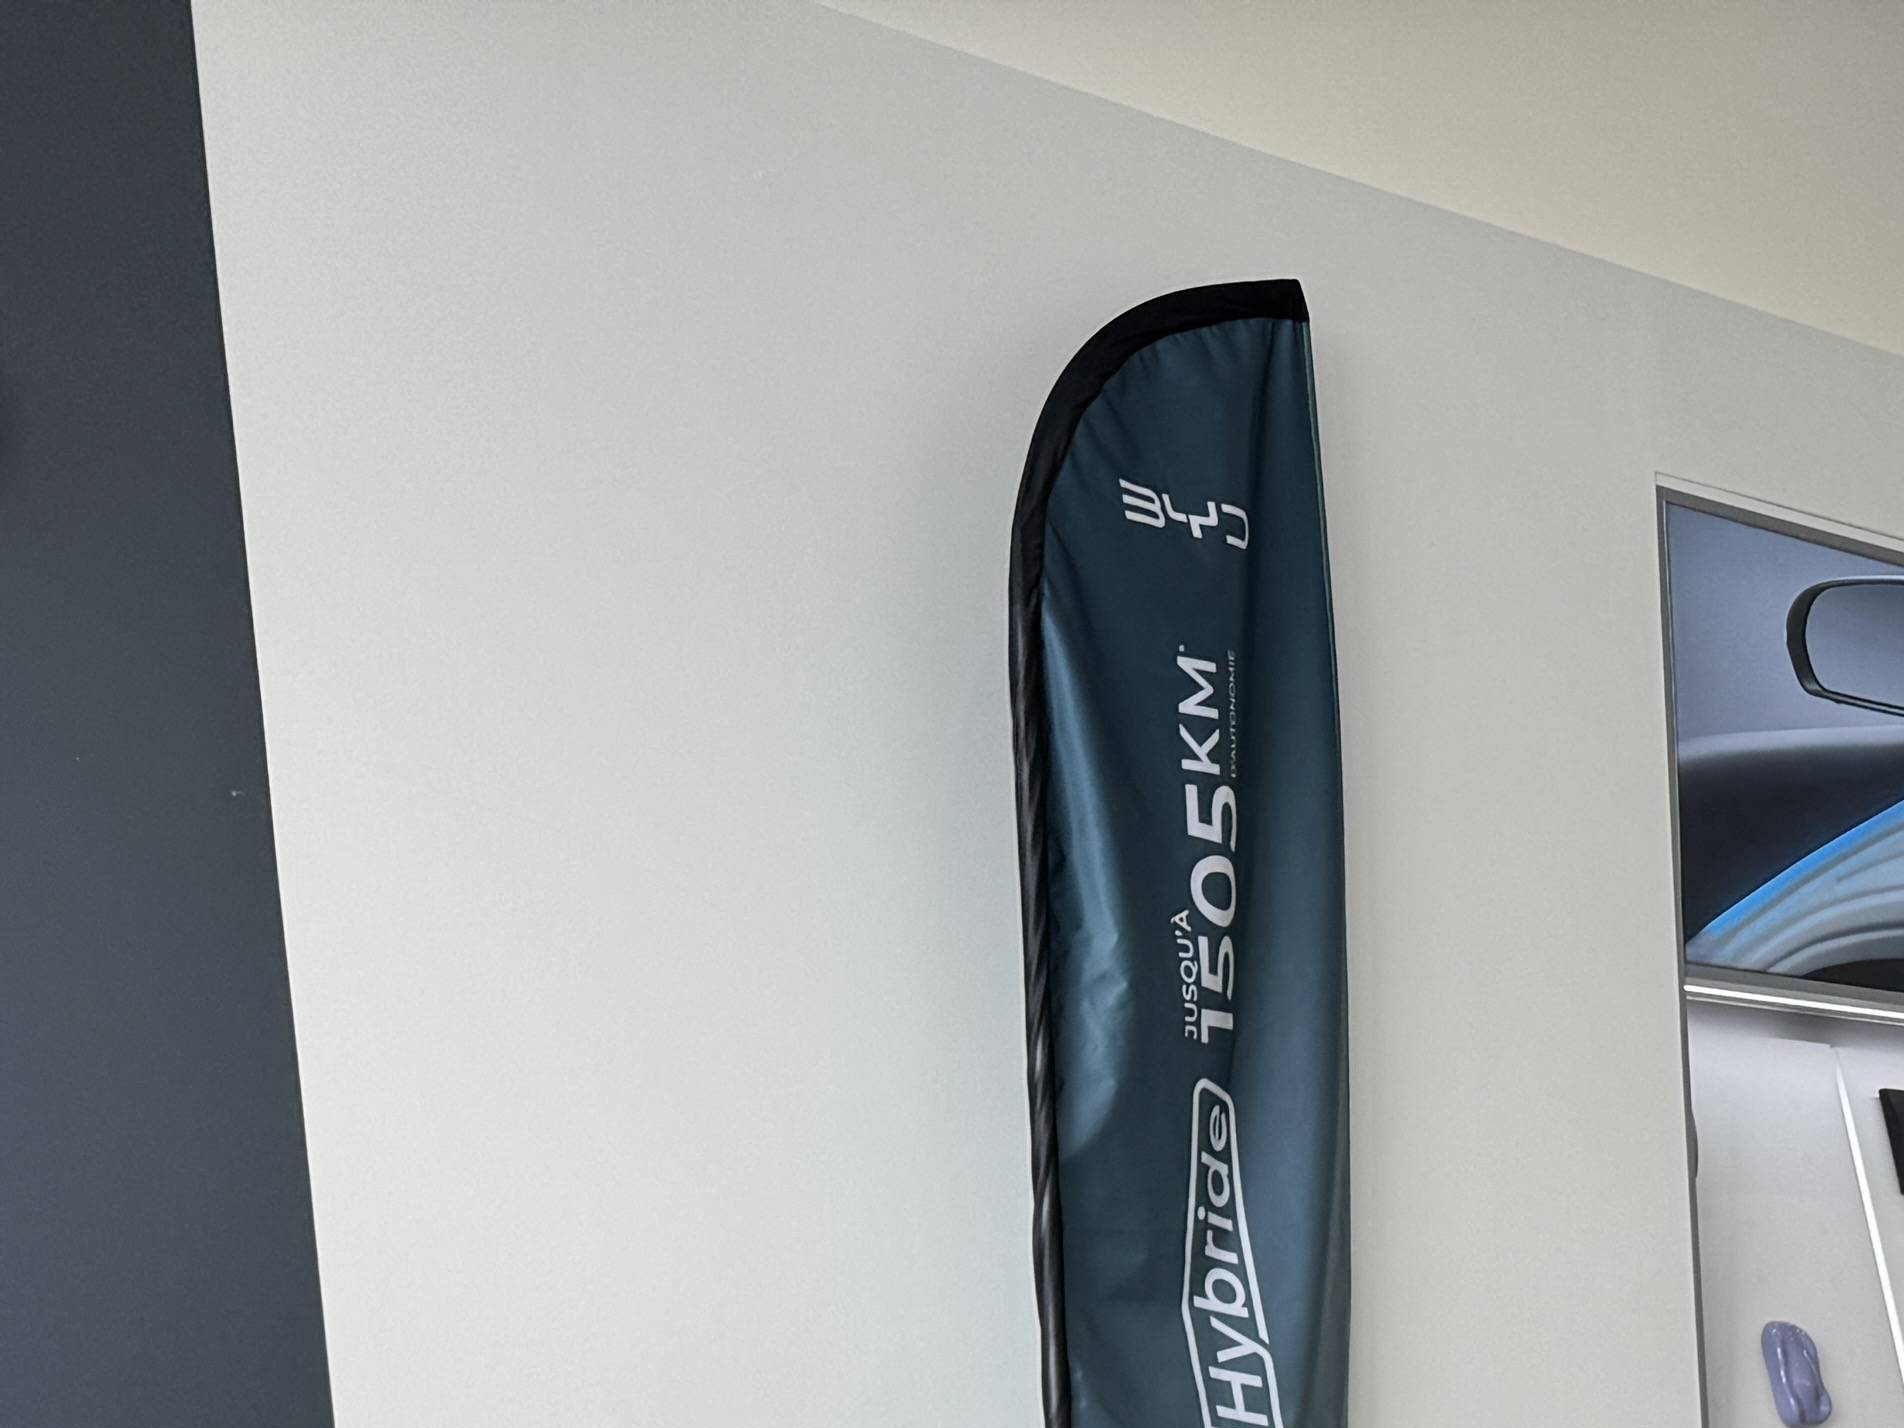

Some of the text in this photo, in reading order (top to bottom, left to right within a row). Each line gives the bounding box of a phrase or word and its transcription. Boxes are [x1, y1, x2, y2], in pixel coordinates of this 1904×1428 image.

[1229, 648, 1237, 779] D'AUTONOMIE
[1170, 909, 1198, 1041] JUSQU'À
[1193, 1102, 1268, 1421] Hybride
